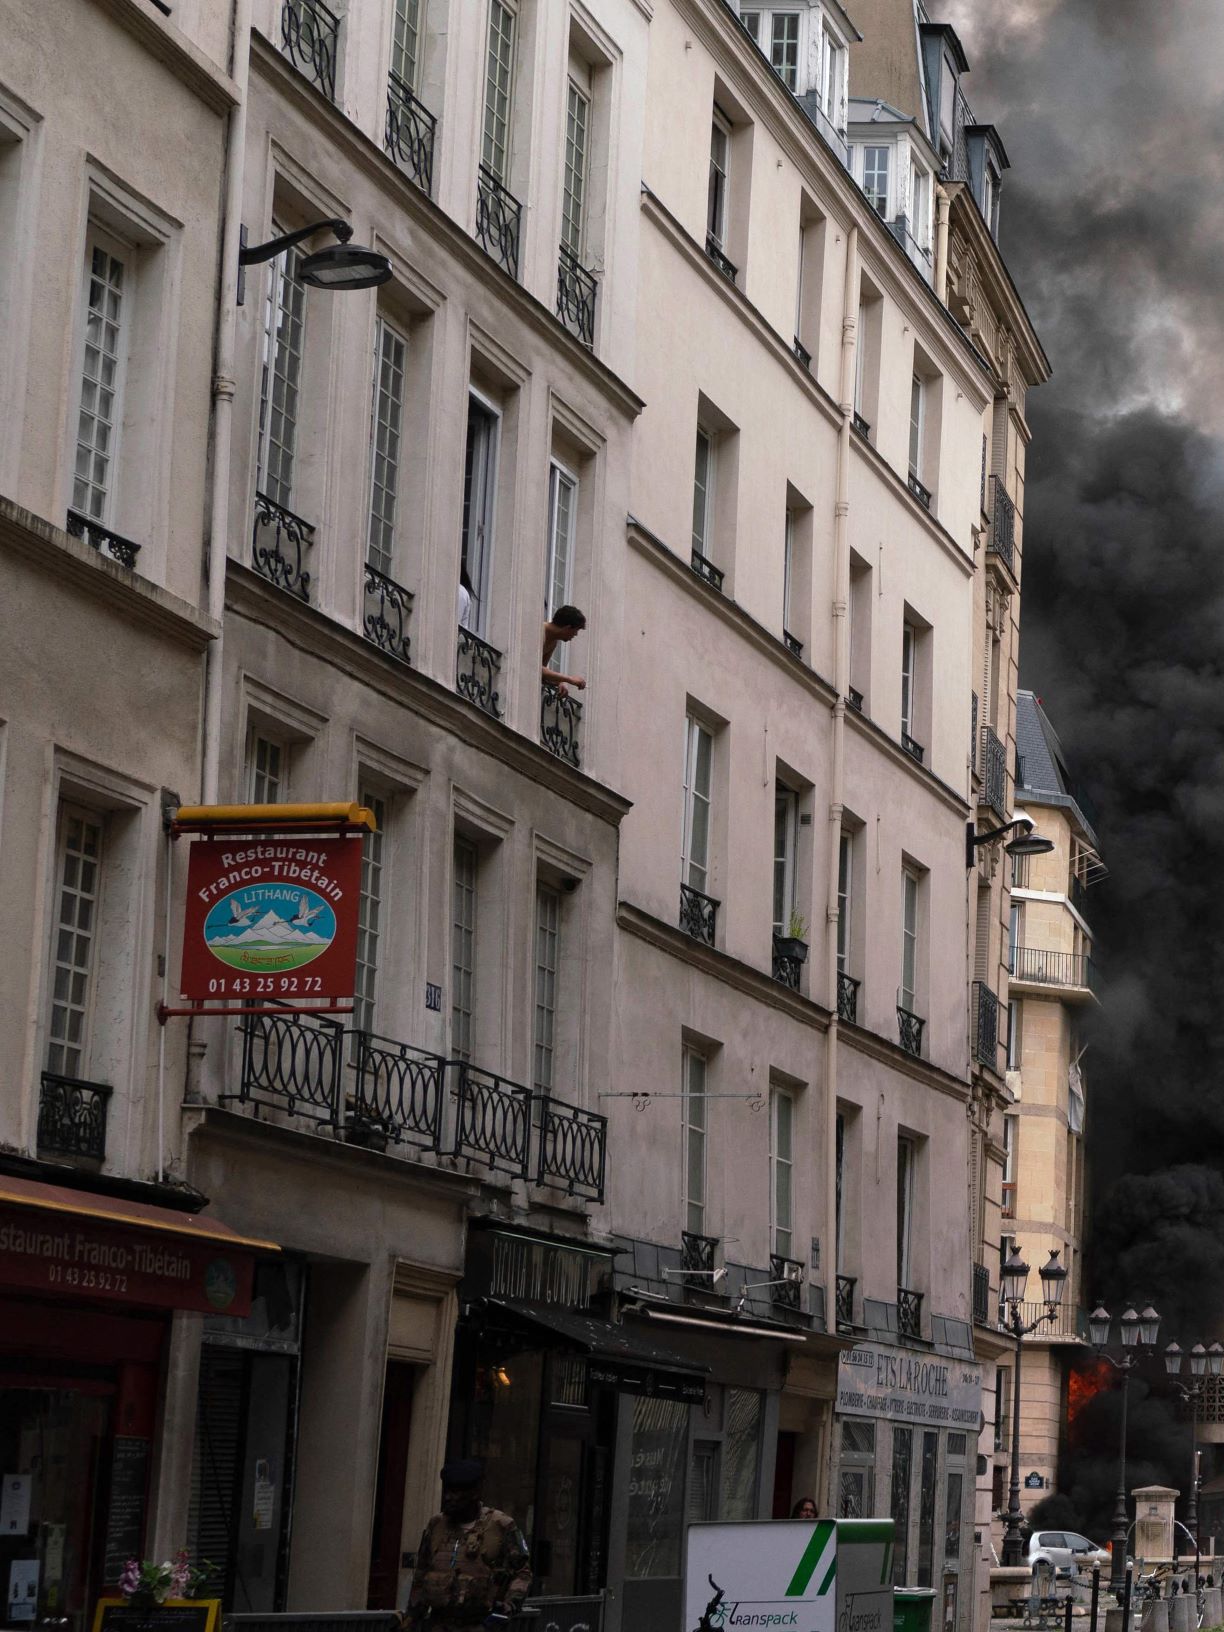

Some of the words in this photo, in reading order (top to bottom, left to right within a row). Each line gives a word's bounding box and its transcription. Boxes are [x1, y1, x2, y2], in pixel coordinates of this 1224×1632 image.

[222, 845, 327, 868] Restaurant
[198, 862, 343, 902] Franco-Tibétain
[244, 889, 300, 903] LITHANG
[209, 977, 225, 993] 01
[232, 978, 250, 992] 43
[256, 978, 274, 992] 25
[280, 977, 298, 992] 92
[304, 977, 322, 991] 72
[426, 985, 440, 1010] 316
[0, 1224, 69, 1259] staurant
[75, 1233, 190, 1279] Franco-Tibétain
[49, 1264, 61, 1282] 01
[65, 1266, 79, 1286] 43
[82, 1269, 96, 1287] 25
[99, 1271, 111, 1290] 92
[114, 1274, 127, 1292] 72
[876, 1354, 897, 1389] ETS
[899, 1358, 949, 1397] LAROCHE
